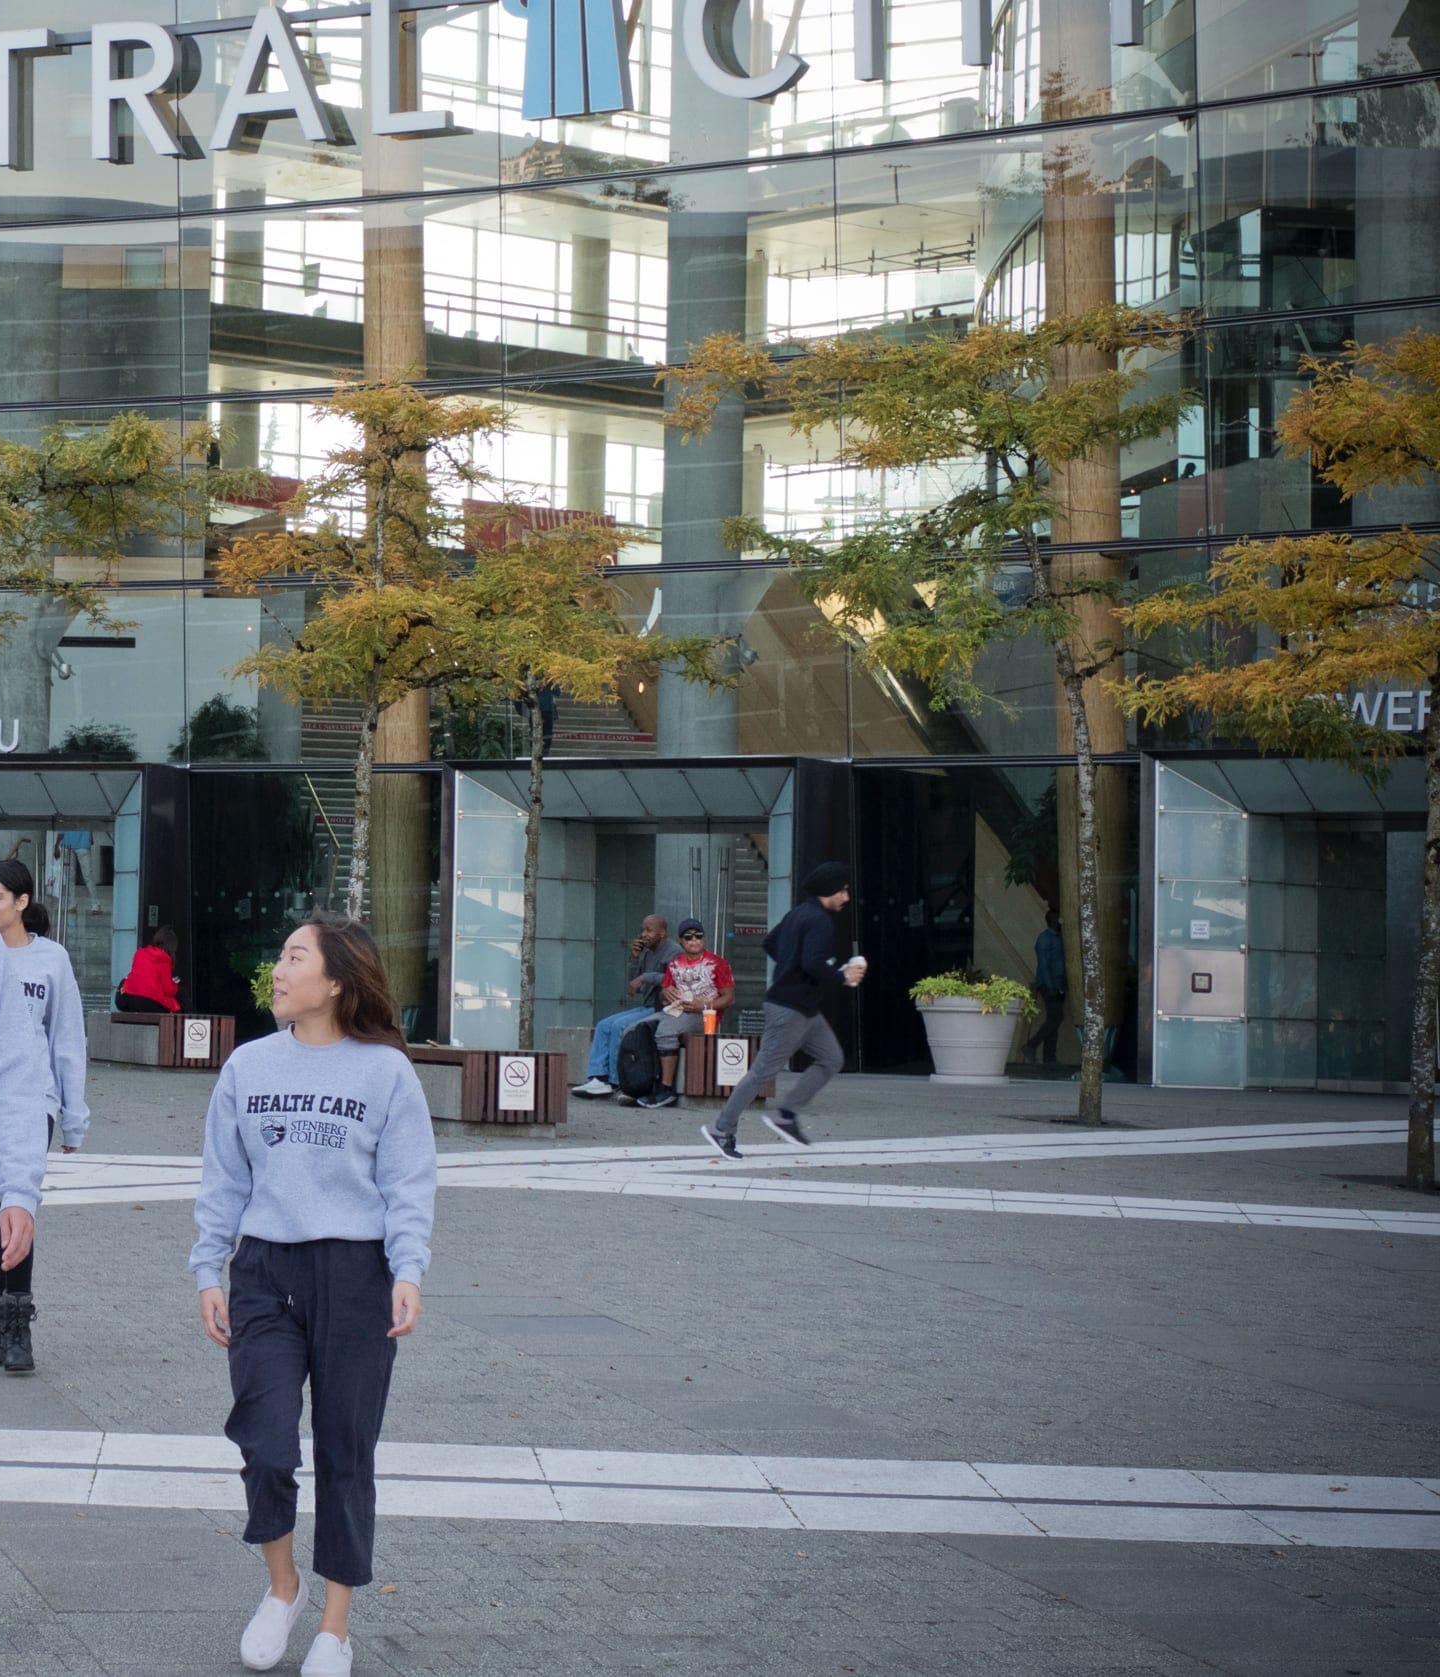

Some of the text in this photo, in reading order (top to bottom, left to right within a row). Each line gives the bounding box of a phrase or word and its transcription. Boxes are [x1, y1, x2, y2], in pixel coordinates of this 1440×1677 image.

[246, 1094, 367, 1122] HEALTH CARE
[289, 1120, 348, 1137] STENBERG
[289, 1131, 346, 1150] COLLEGE
